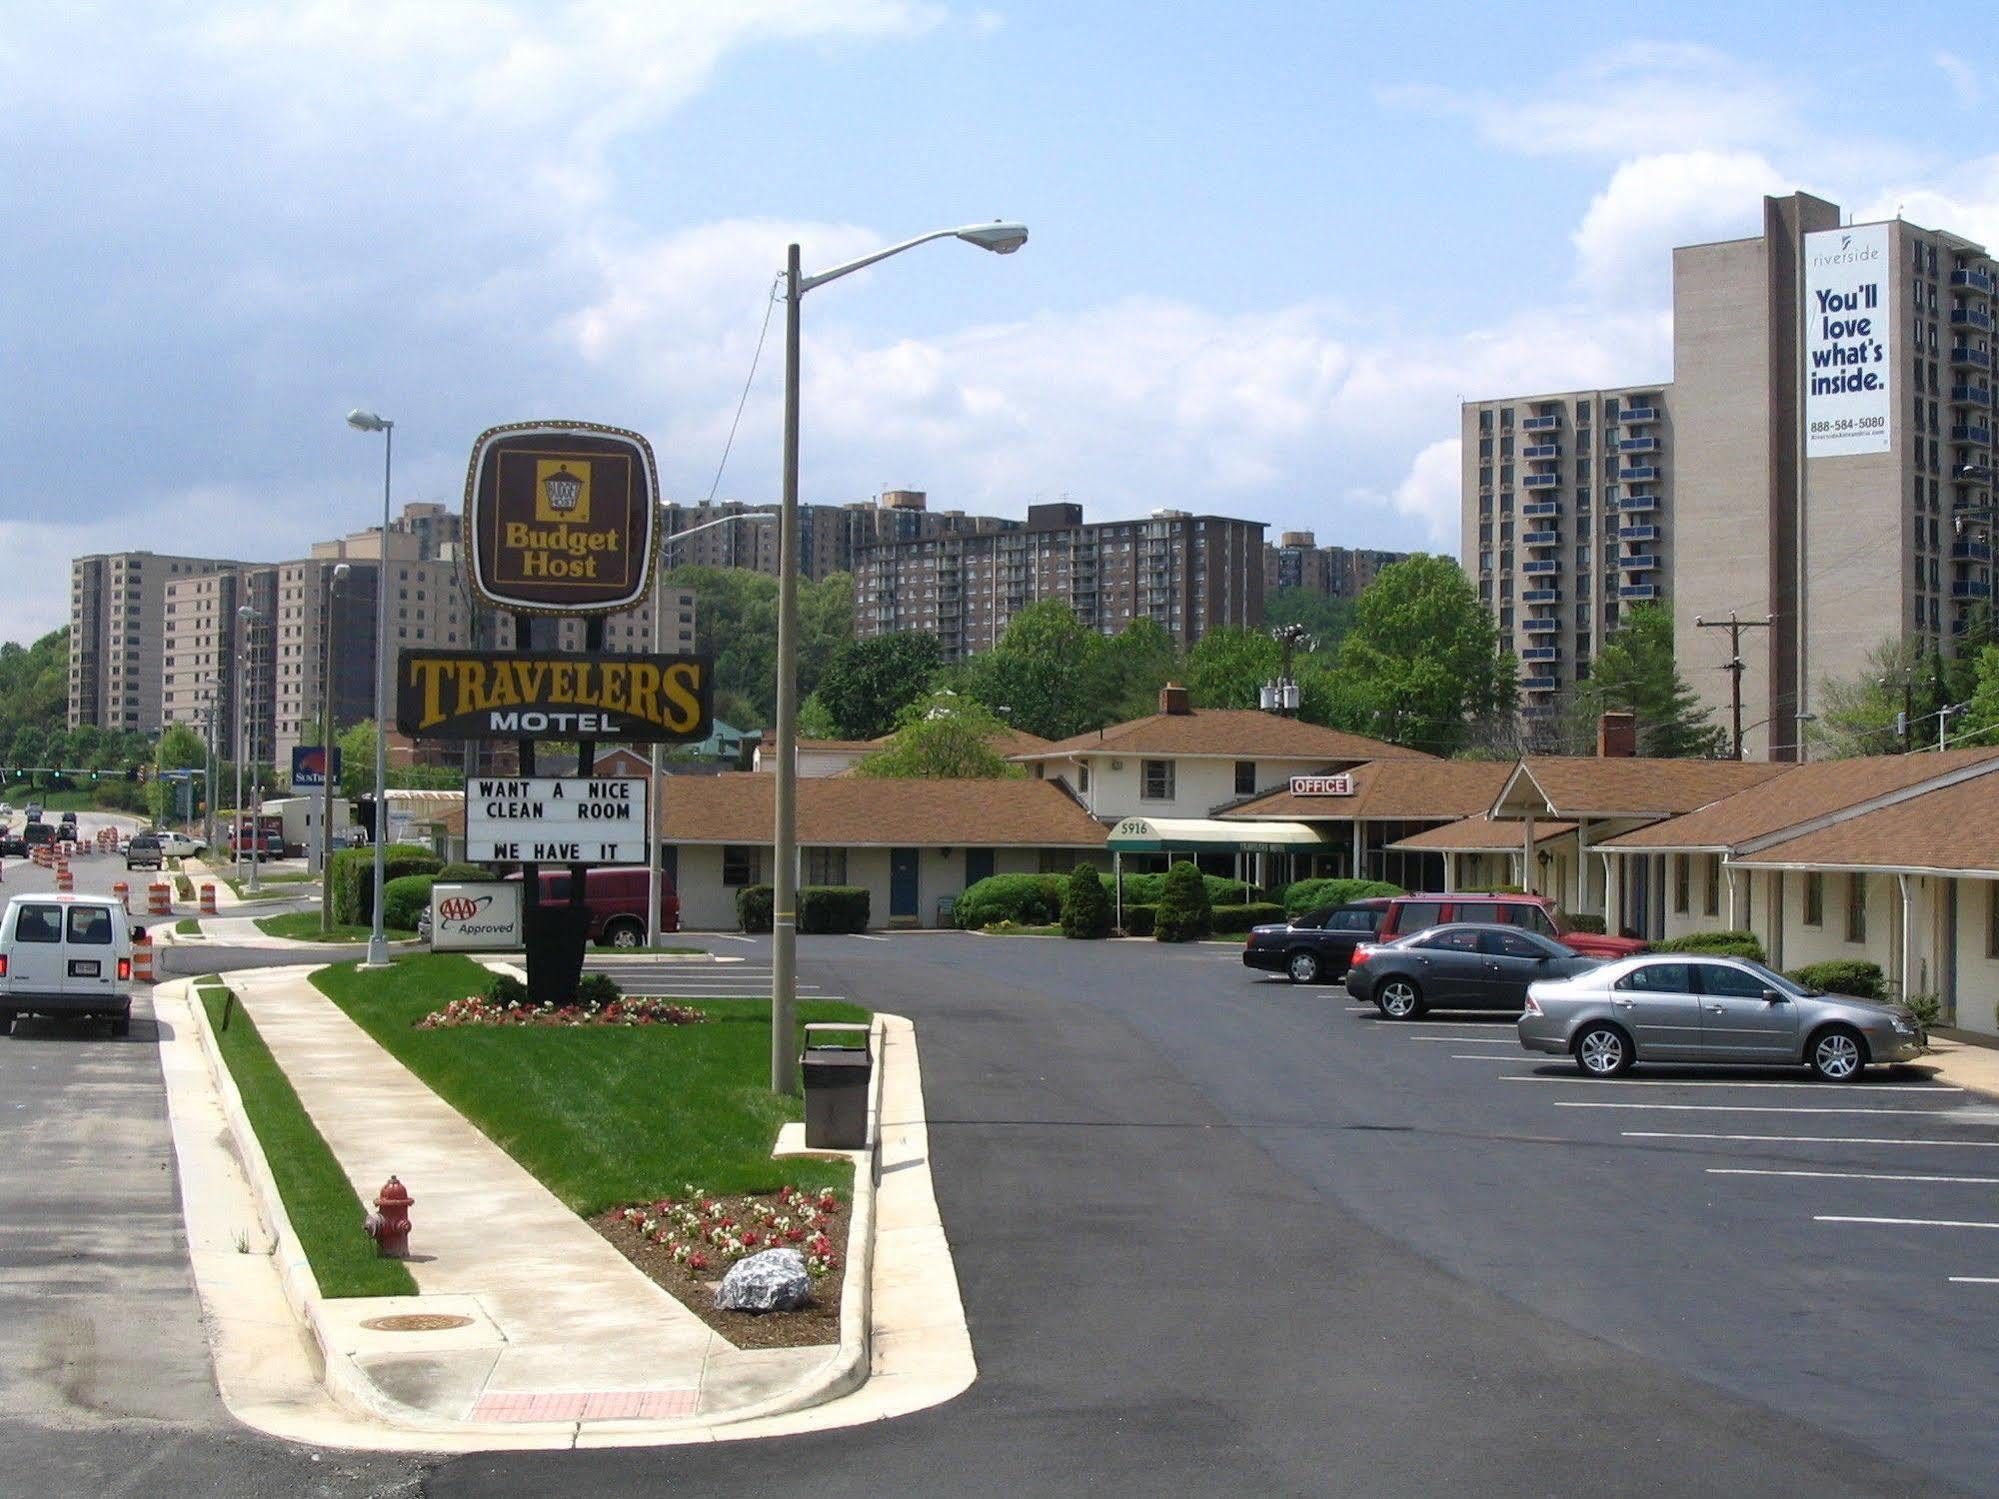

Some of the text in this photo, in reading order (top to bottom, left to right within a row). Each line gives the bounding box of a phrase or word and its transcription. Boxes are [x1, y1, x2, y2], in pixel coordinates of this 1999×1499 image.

[1813, 244, 1879, 267] riverside
[1816, 283, 1878, 314] You'll
[1823, 316, 1872, 340] love
[1812, 338, 1883, 368] what's
[1811, 367, 1885, 396] inside.
[1810, 416, 1885, 433] 888-584-5080
[505, 522, 619, 556] Budget
[521, 551, 598, 578] Host
[410, 659, 701, 734] TRAVELERS
[489, 711, 621, 733] MOTEL
[479, 781, 630, 799] WANT A NICE
[1294, 779, 1346, 793] OFFICE
[486, 802, 630, 819] CLEAN ROOM
[1121, 822, 1148, 835] 5916
[493, 843, 619, 860] WE HAVE IT
[442, 897, 475, 921] AAA
[459, 923, 515, 936] Approved
